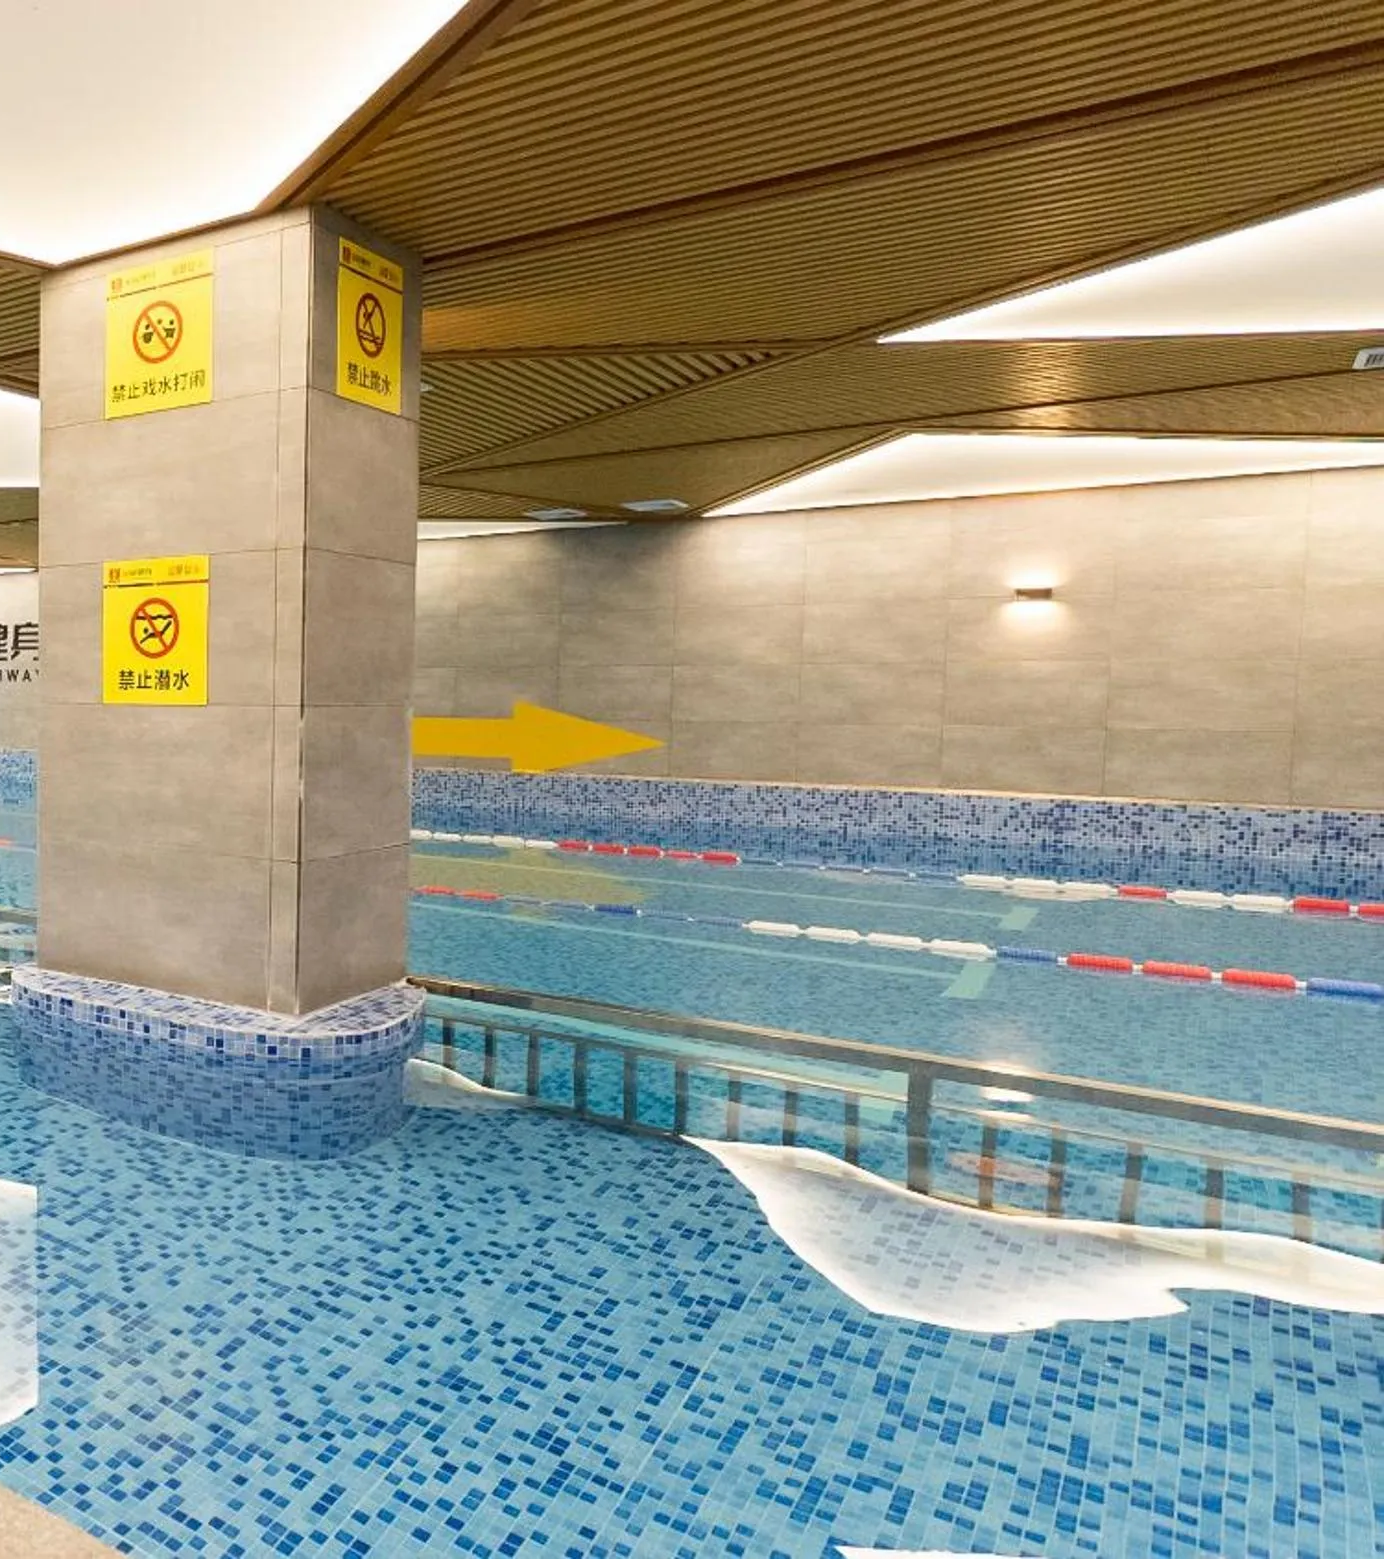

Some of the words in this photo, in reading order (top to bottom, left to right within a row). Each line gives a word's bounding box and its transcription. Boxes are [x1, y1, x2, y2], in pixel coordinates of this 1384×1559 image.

[111, 370, 205, 402] 禁止戏水打闹
[348, 362, 392, 396] 禁止跳水
[118, 669, 190, 691] 禁止潜水
